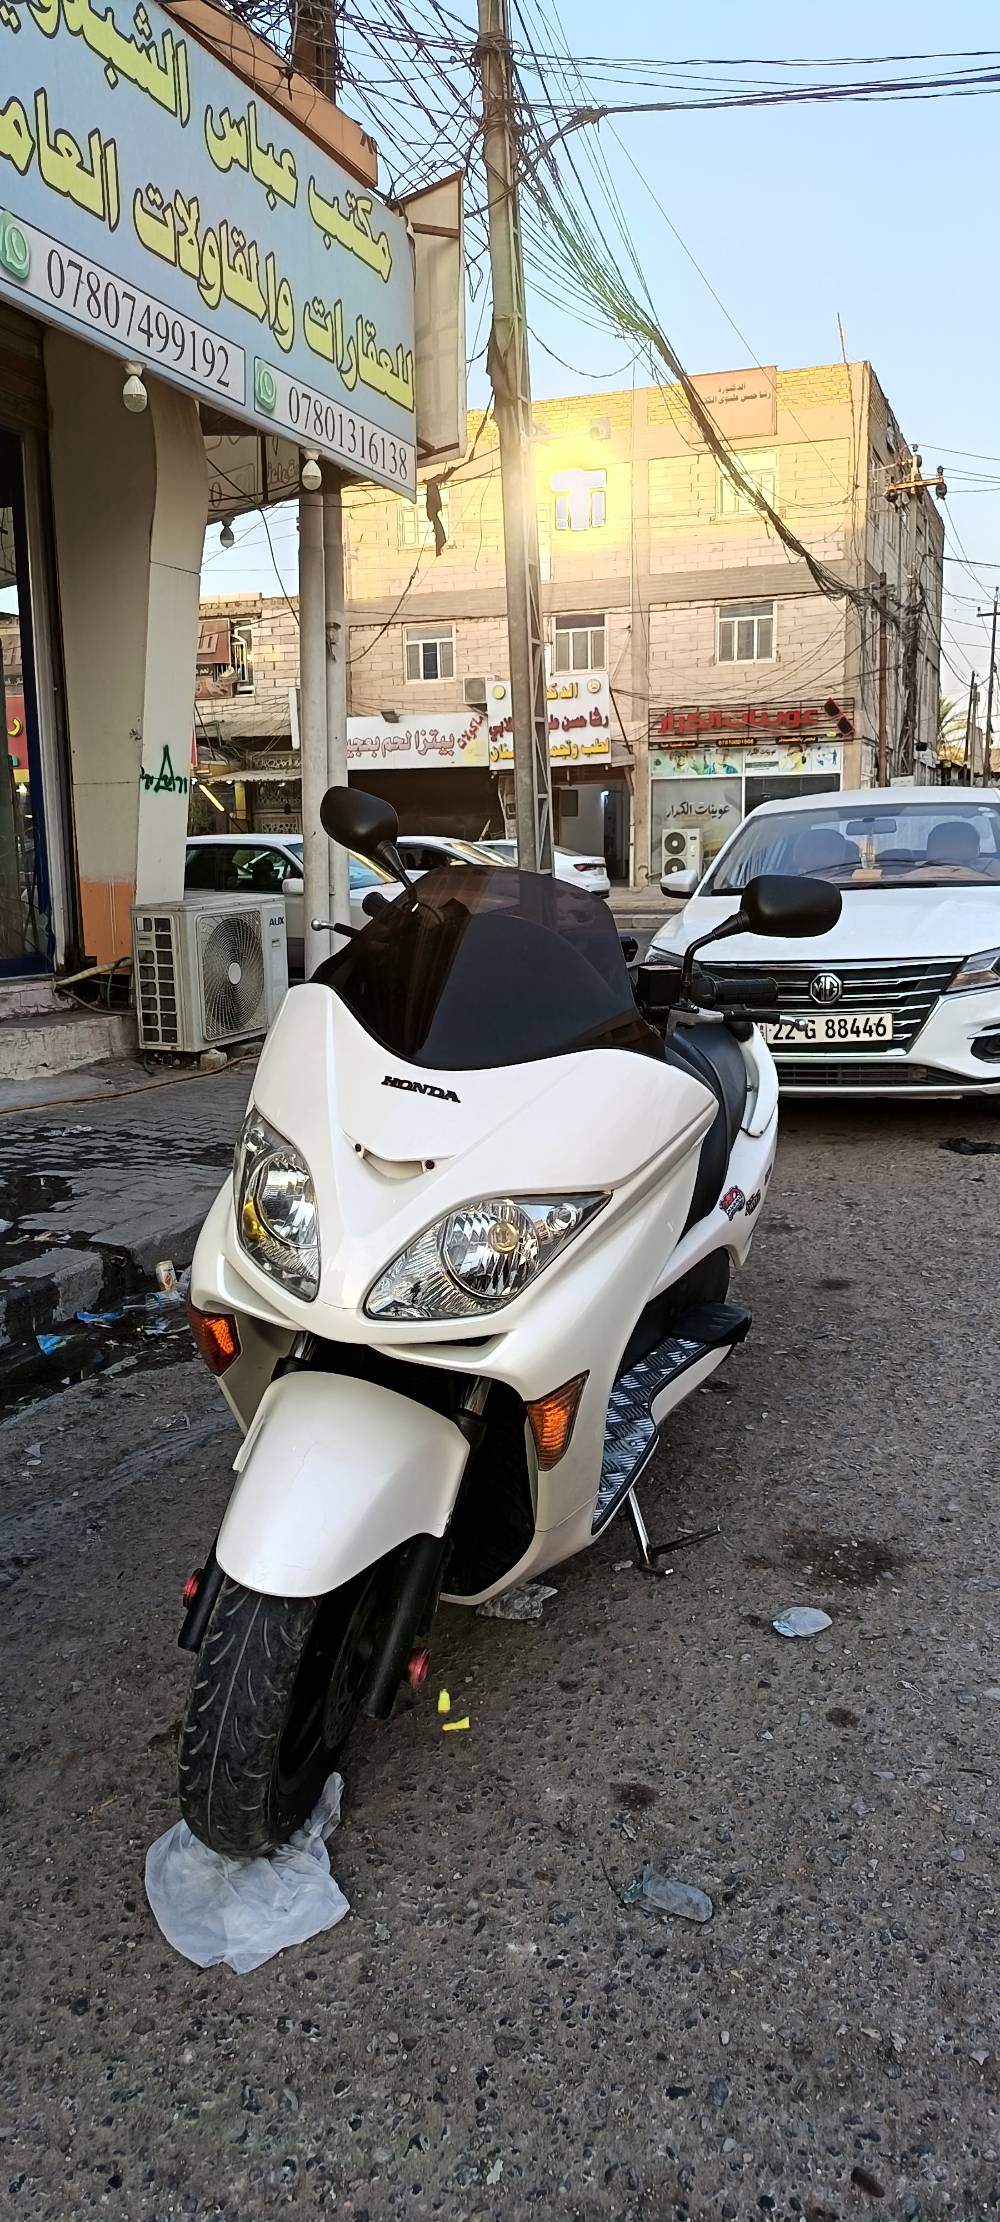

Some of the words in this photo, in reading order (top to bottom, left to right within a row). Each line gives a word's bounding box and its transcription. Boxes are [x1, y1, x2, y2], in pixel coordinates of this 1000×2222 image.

[0, 87, 120, 232] العام
[205, 100, 298, 211] عباس
[308, 175, 392, 283] مكتب
[133, 182, 295, 353] والمقاولات
[47, 249, 230, 388] 07807499192
[303, 296, 414, 413] للعقارات
[288, 386, 408, 482] 07801316138
[562, 715, 588, 732] حسن
[588, 706, 609, 728] رشا
[658, 708, 722, 736] الكرار
[721, 707, 818, 730] عوينات
[347, 736, 381, 758] بعجي
[381, 730, 412, 758] لحم
[414, 729, 455, 757] بيتزا
[666, 801, 693, 818] الكرار
[695, 804, 730, 820] عوينات
[269, 916, 285, 927] AUX
[812, 975, 840, 1002] MG
[772, 1022, 796, 1041] 22
[825, 1016, 888, 1039] 88446
[381, 1075, 461, 1103] HONDA
